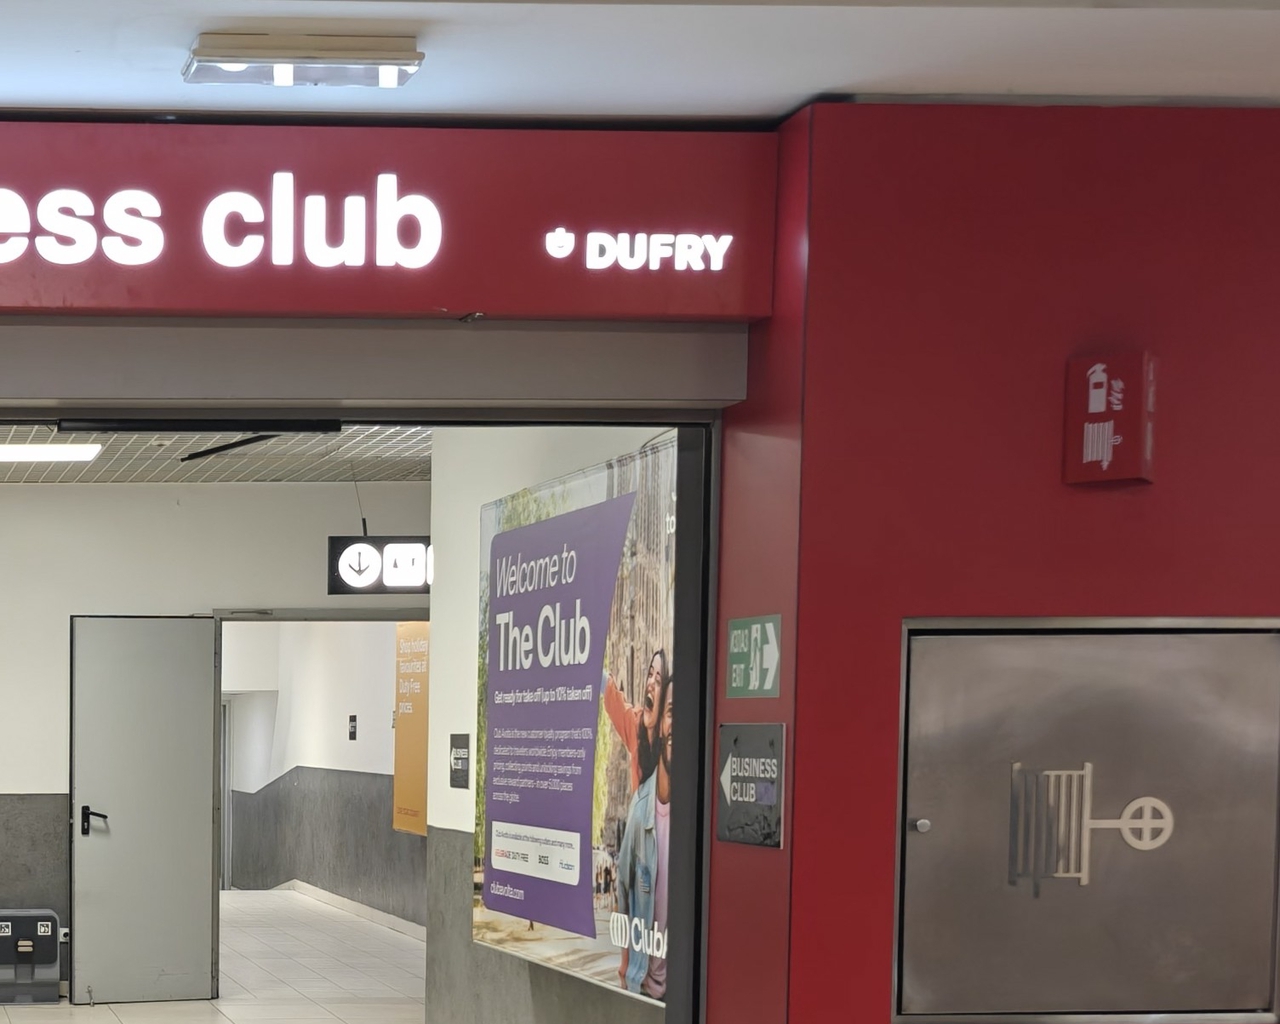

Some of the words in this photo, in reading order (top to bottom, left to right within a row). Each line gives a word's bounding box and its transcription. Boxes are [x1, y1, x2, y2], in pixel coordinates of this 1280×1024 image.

[202, 170, 443, 268] club
[586, 232, 733, 271] DUFRY
[496, 552, 559, 598] Welcome
[561, 543, 577, 584] to
[496, 610, 533, 671] The
[537, 598, 590, 668] Club
[494, 691, 503, 704] Get
[503, 690, 516, 706] ready
[731, 757, 777, 778] BUSINESS
[731, 782, 756, 803] CLUB
